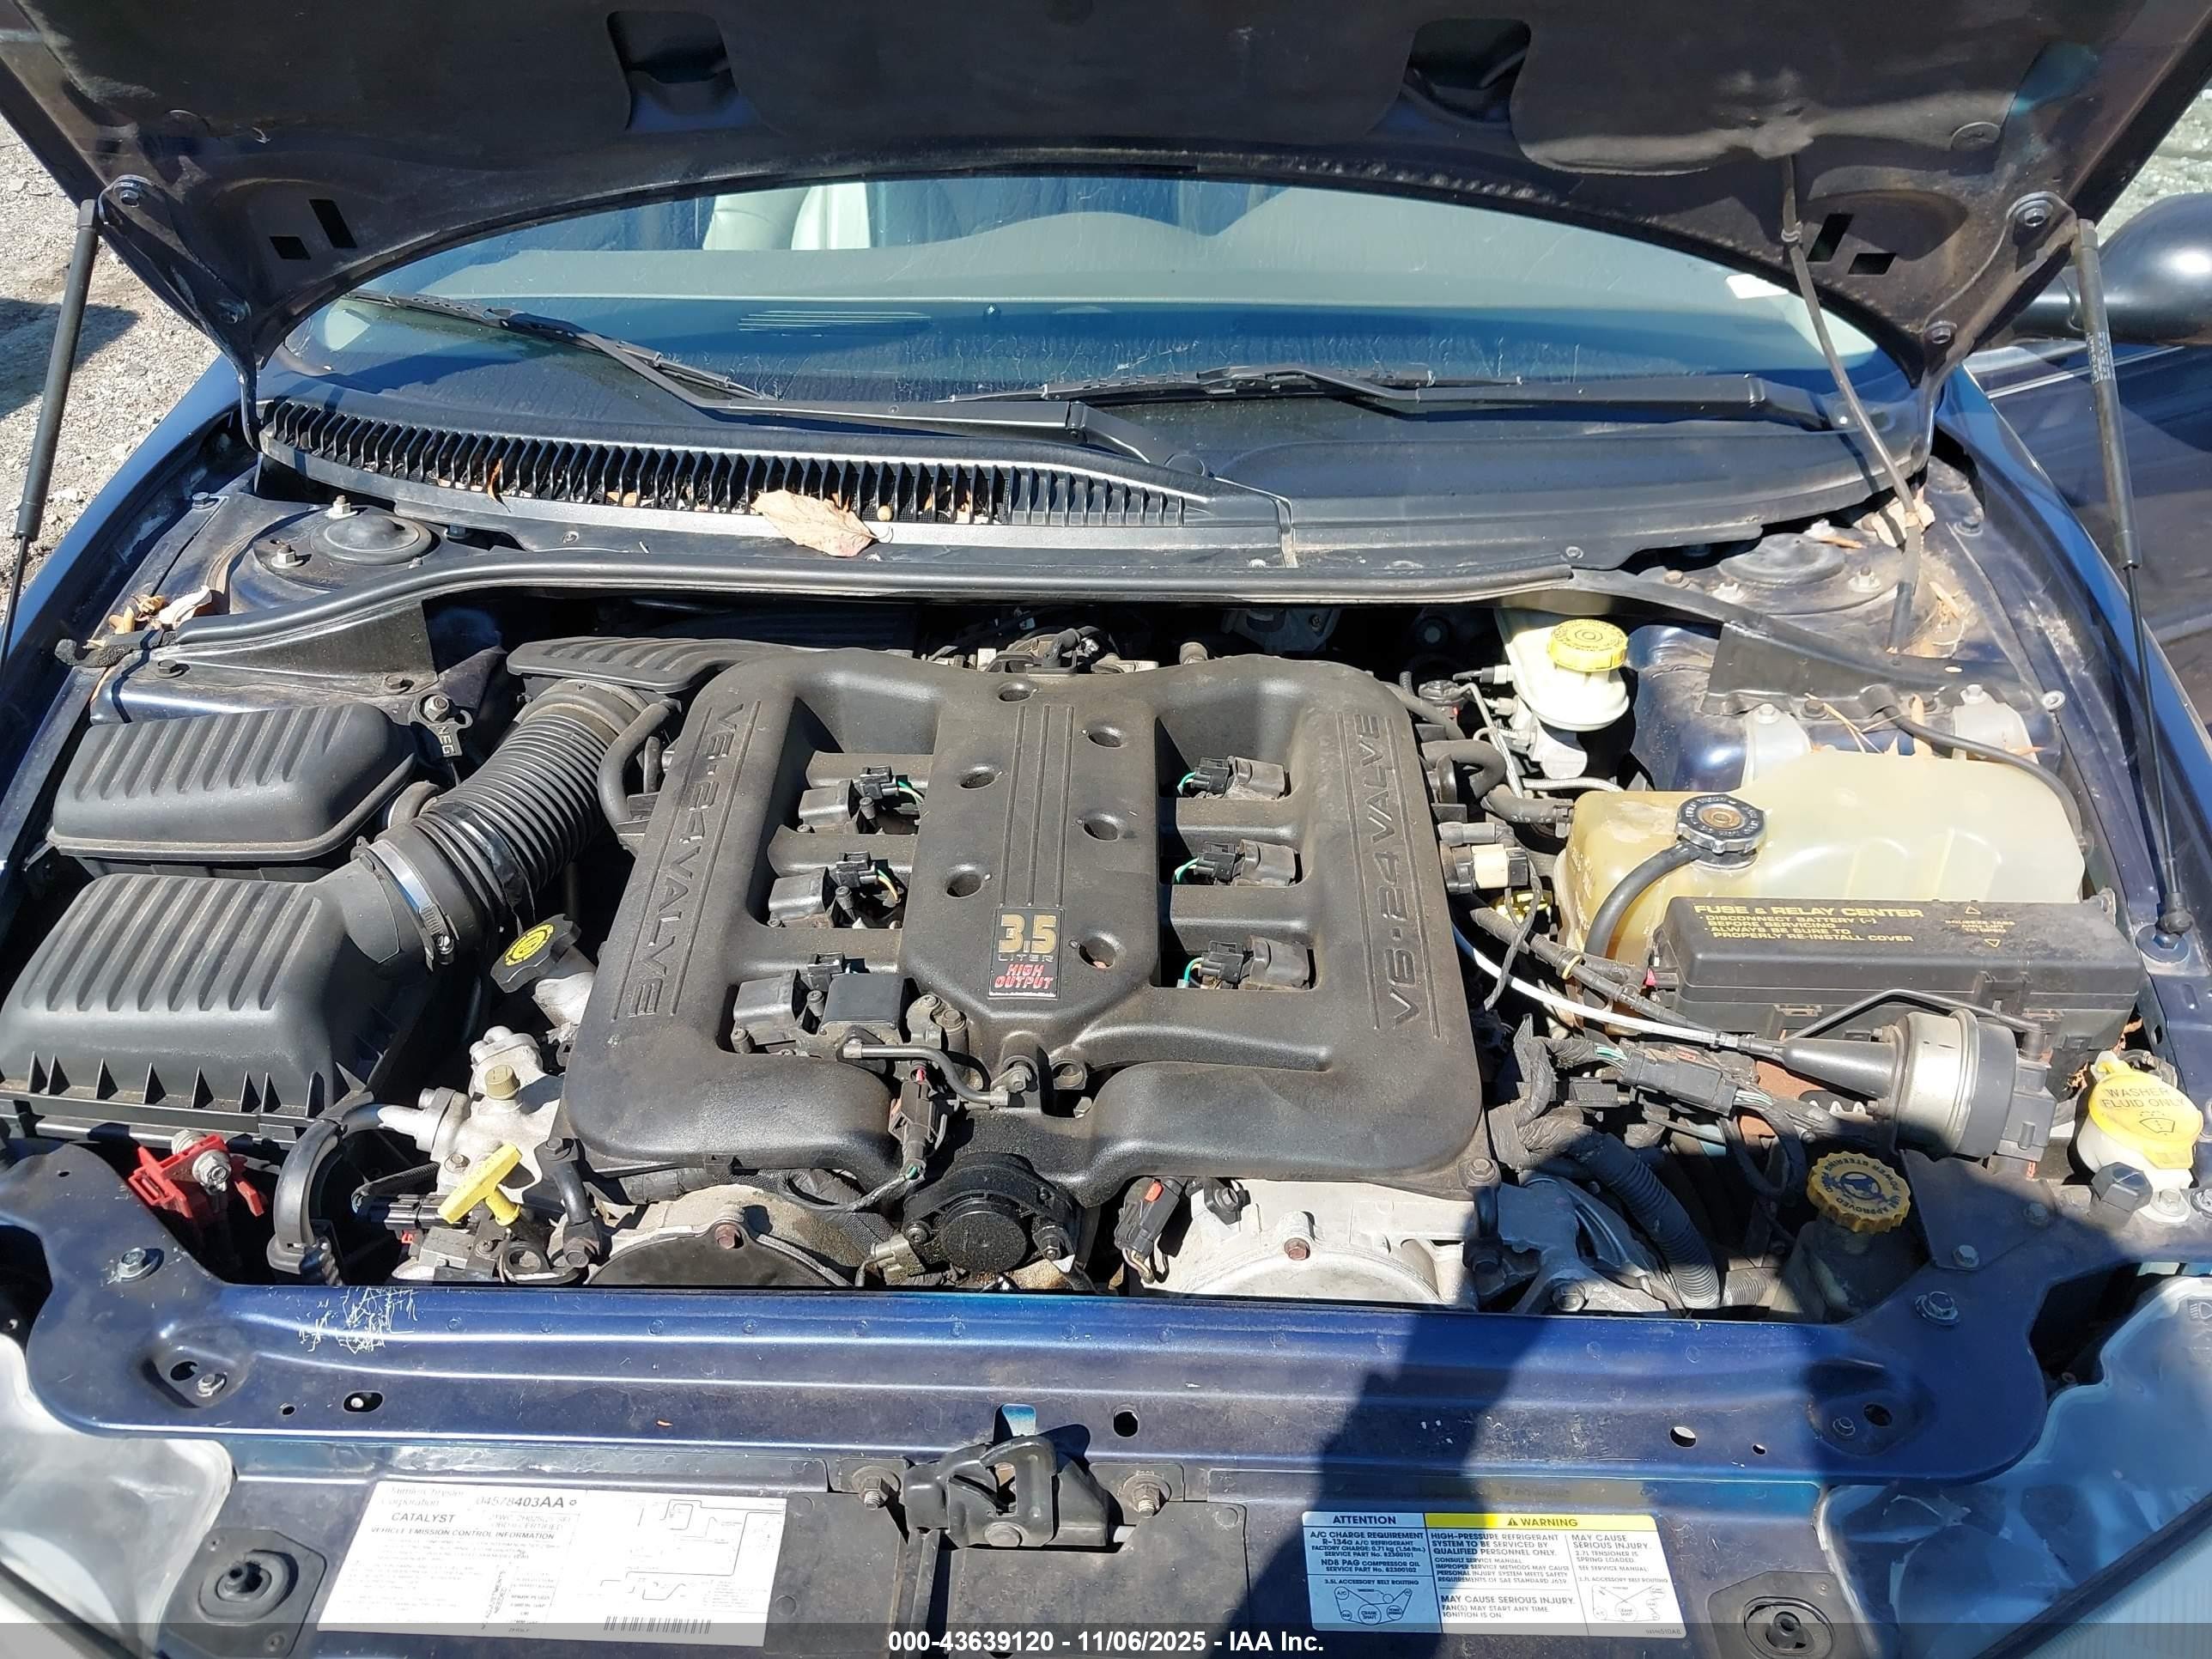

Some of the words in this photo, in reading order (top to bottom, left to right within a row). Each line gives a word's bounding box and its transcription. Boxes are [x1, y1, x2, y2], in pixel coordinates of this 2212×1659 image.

[435, 726, 456, 754] NEG
[1771, 907, 1835, 915] RELAY
[1841, 908, 1924, 917] CENTER
[998, 915, 1057, 953] 3.5
[1006, 964, 1044, 976] HIGH
[994, 975, 1054, 989] OUTPUT
[2105, 1088, 2169, 1097] WASHER
[2102, 1098, 2144, 1109] FLUID
[2148, 1098, 2185, 1108] ONLY
[1825, 1158, 1869, 1171] STEERING
[1872, 1164, 1901, 1191] POWER
[1836, 1197, 1889, 1215] APPROVED
[392, 1512, 456, 1523] CATALYST
[1333, 1516, 1396, 1525] ATTENTION
[1521, 1517, 1578, 1527] WARNING
[495, 1531, 555, 1540] INFORMATION
